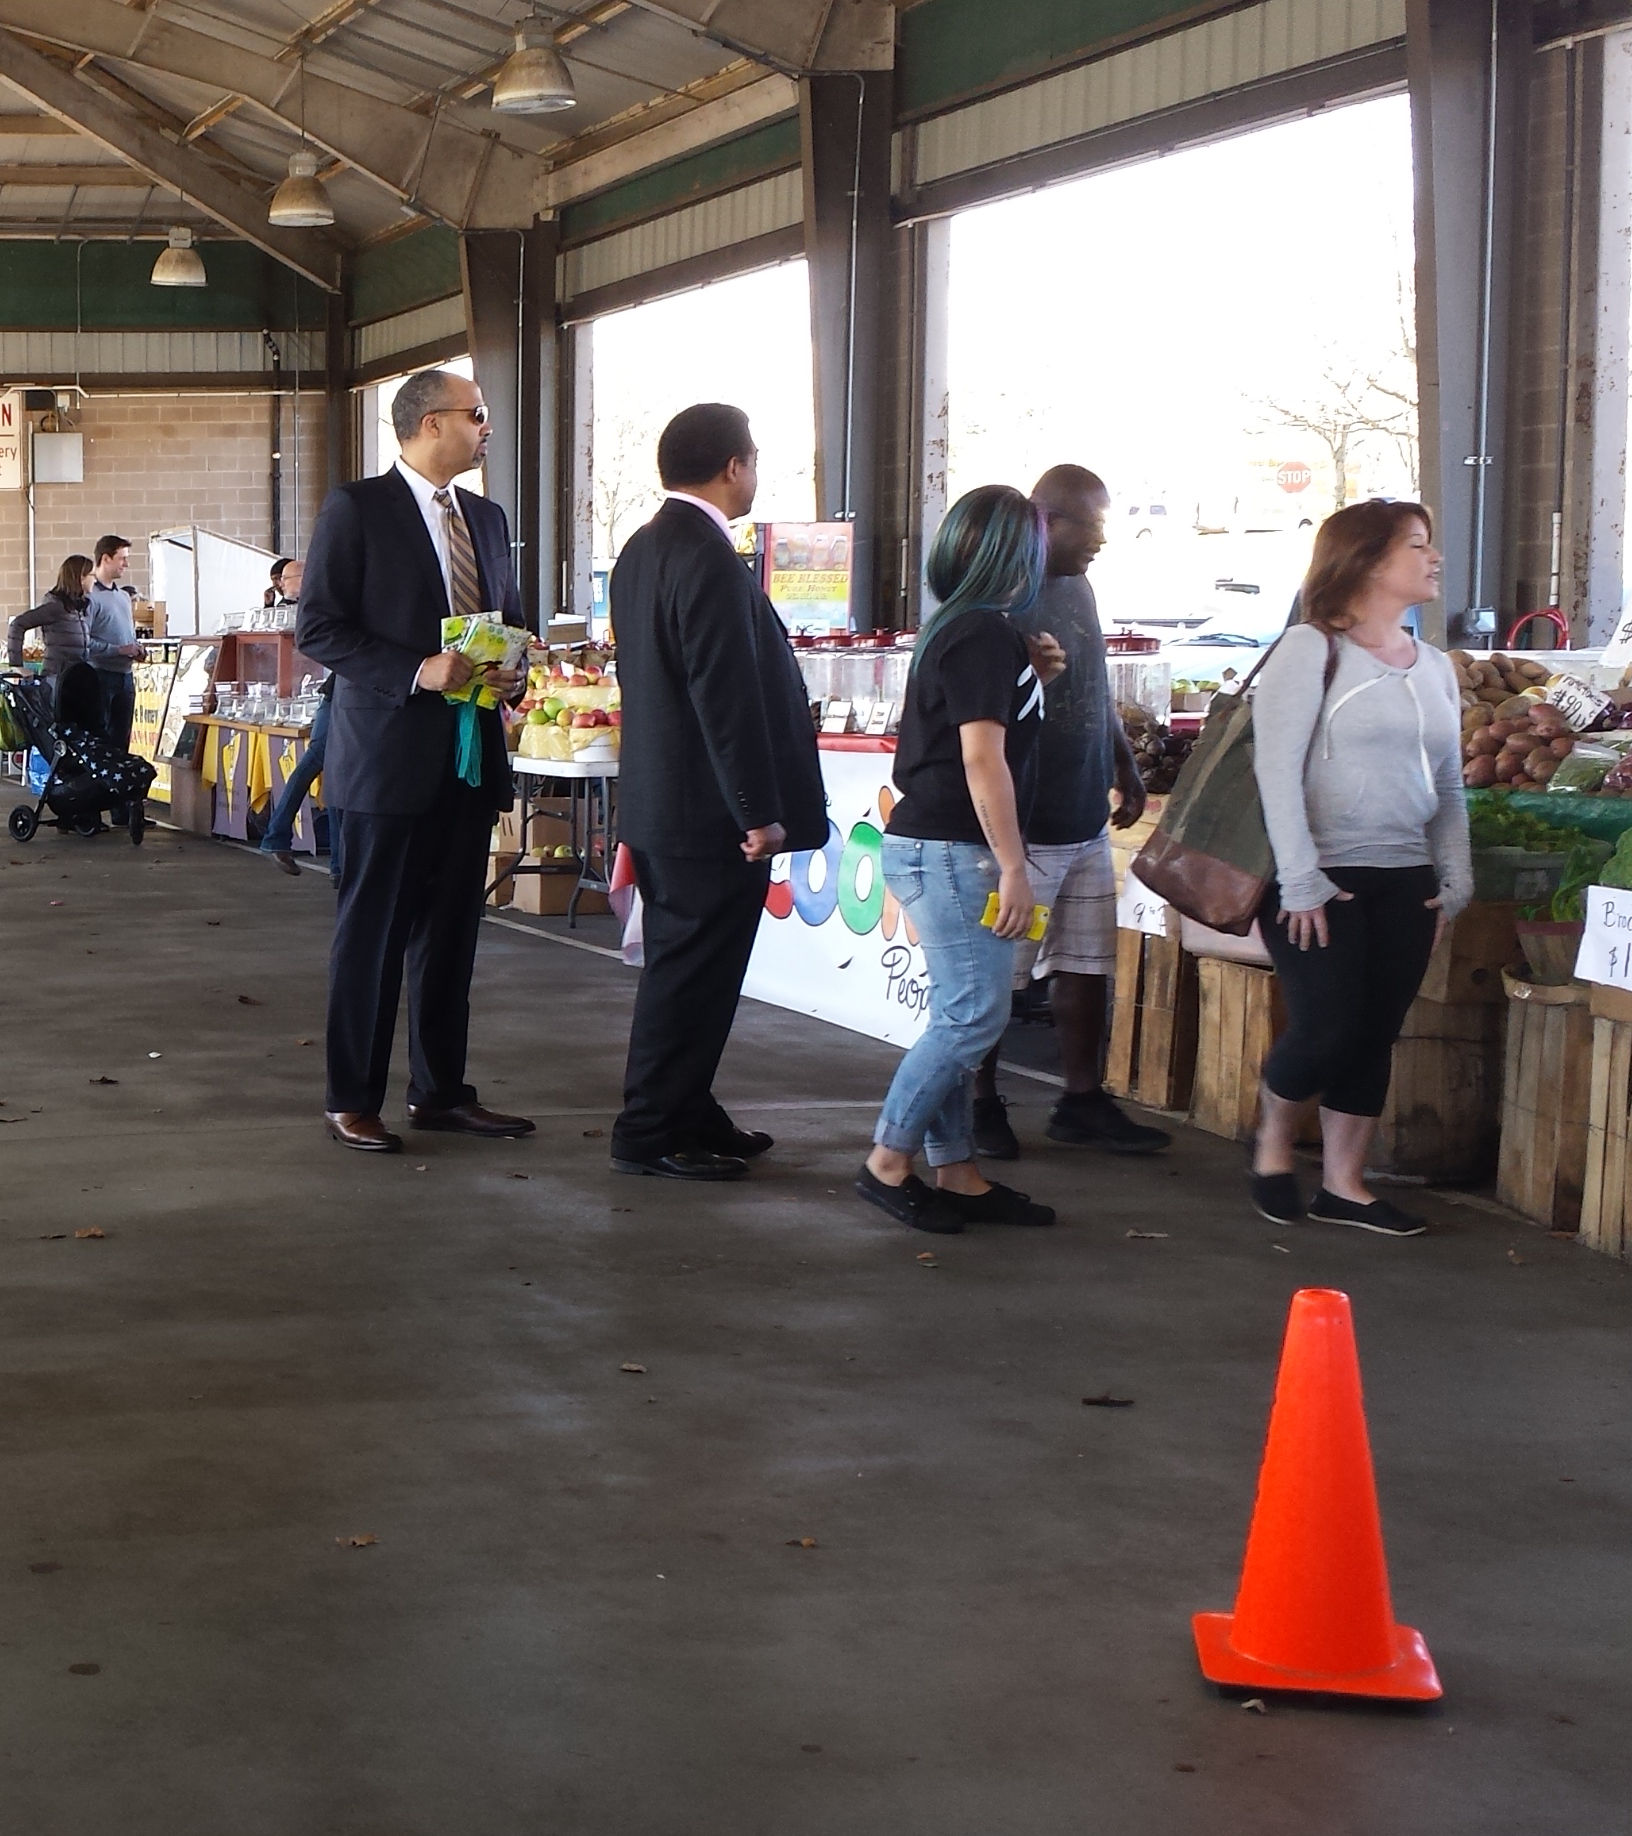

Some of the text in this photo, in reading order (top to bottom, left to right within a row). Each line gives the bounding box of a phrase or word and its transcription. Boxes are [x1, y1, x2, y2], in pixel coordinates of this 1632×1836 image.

[1278, 470, 1311, 485] STOP
[773, 574, 848, 583] BEE BLESSED
